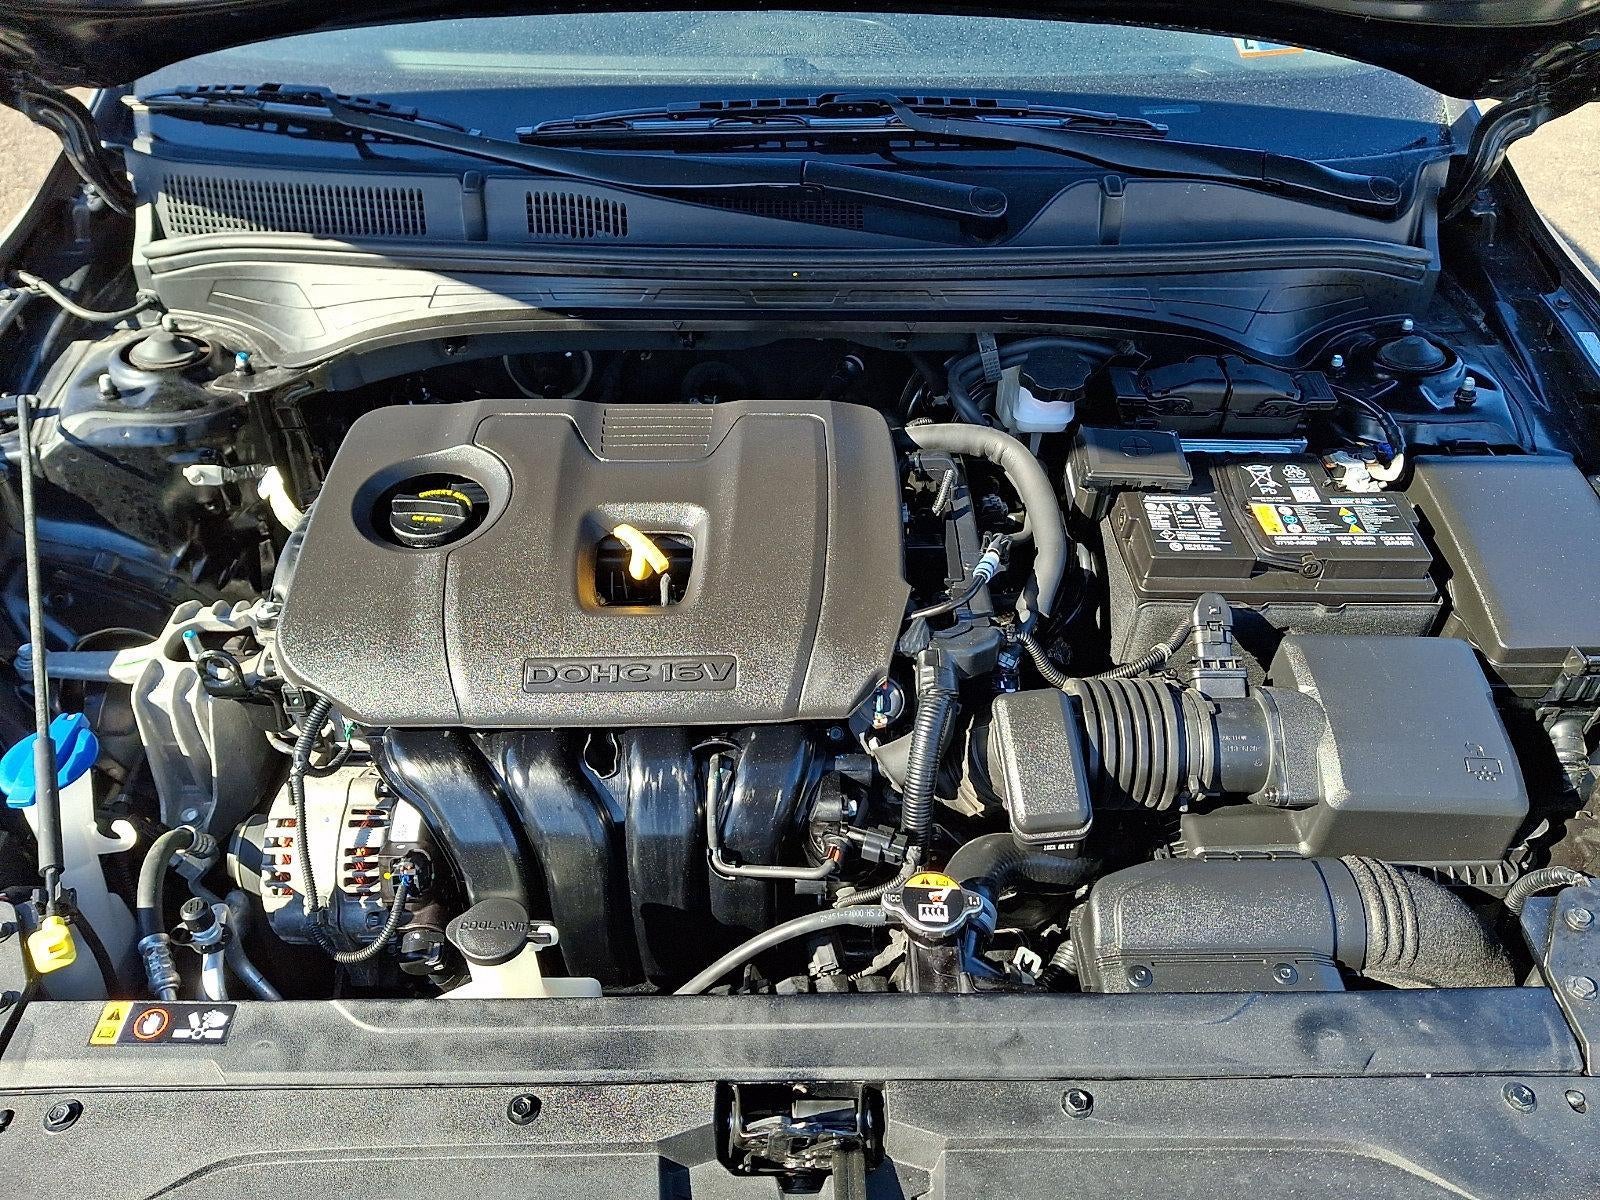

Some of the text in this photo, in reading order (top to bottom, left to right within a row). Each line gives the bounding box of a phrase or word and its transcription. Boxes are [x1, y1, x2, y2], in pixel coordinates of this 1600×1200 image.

[1260, 487, 1277, 495] Pb
[526, 662, 735, 684] DOHC 16V
[968, 896, 980, 905] 1.1
[460, 920, 529, 932] COOLANT
